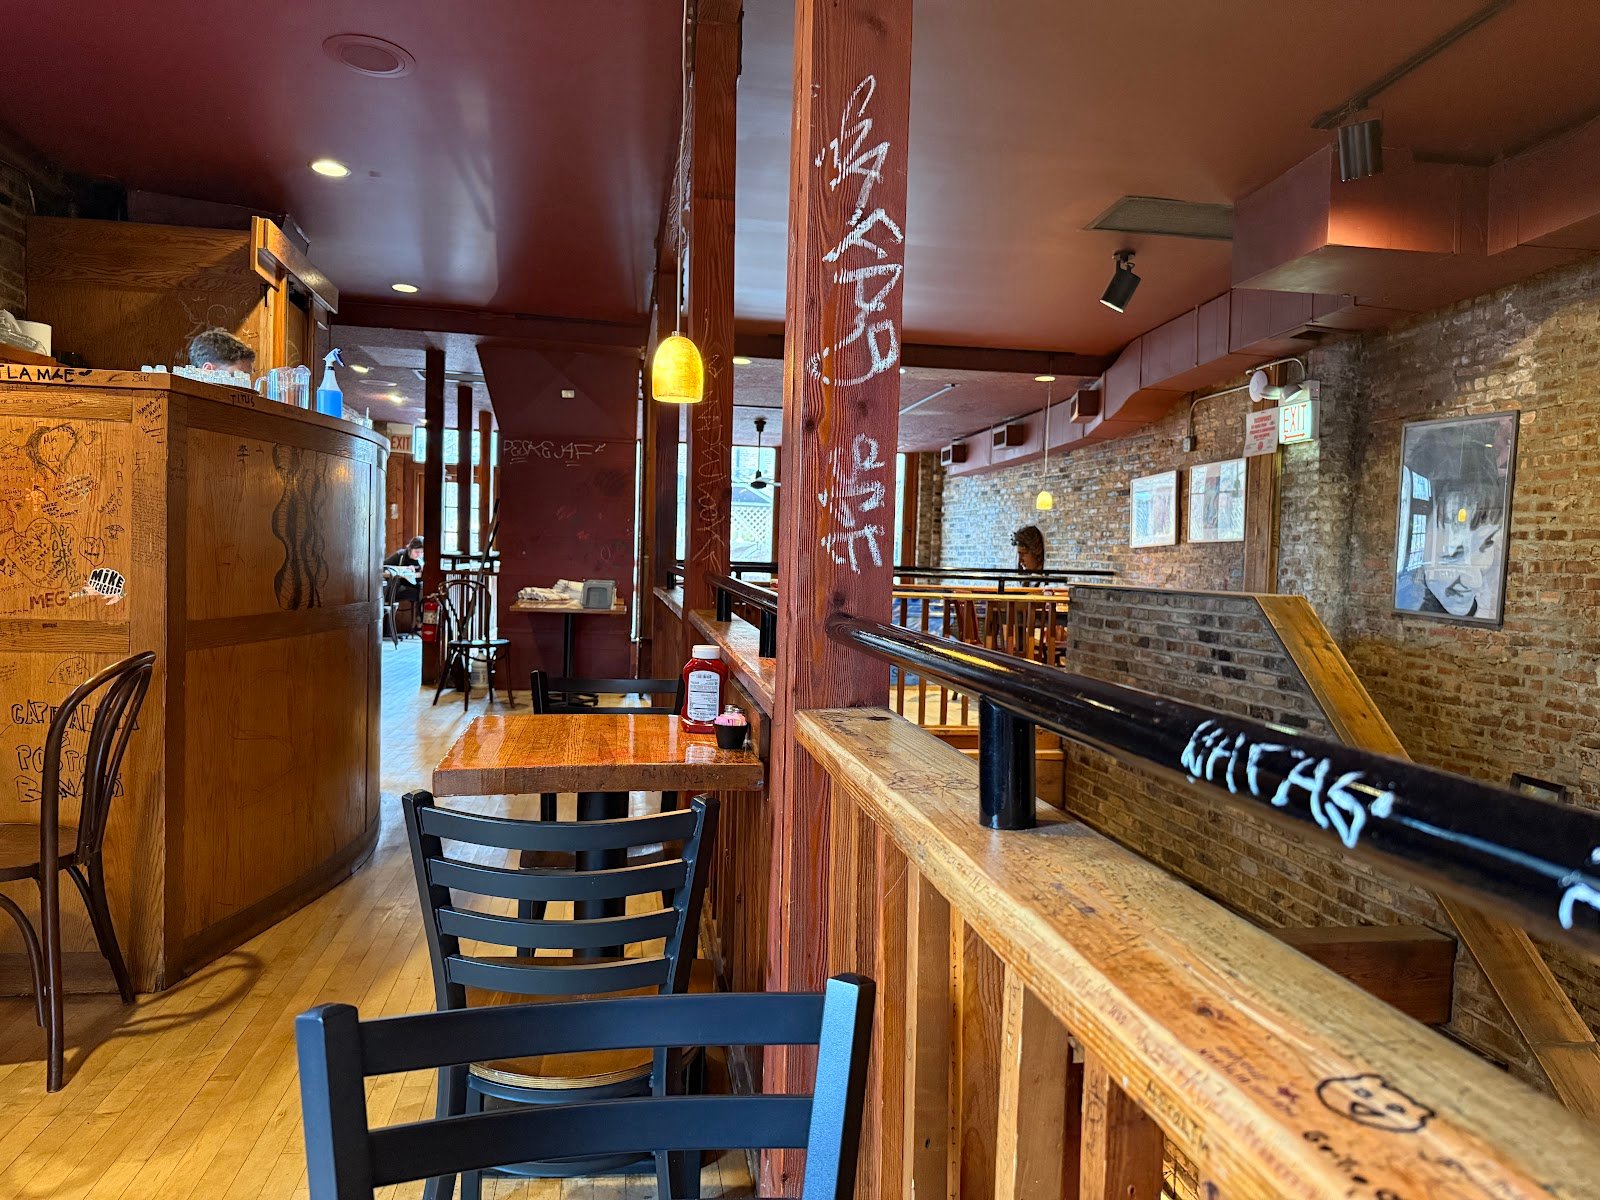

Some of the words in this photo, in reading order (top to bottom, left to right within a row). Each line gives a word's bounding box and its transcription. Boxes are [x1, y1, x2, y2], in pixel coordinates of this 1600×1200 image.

[1283, 403, 1307, 433] EXIT
[391, 436, 410, 449] EXIT
[29, 591, 67, 610] MEG
